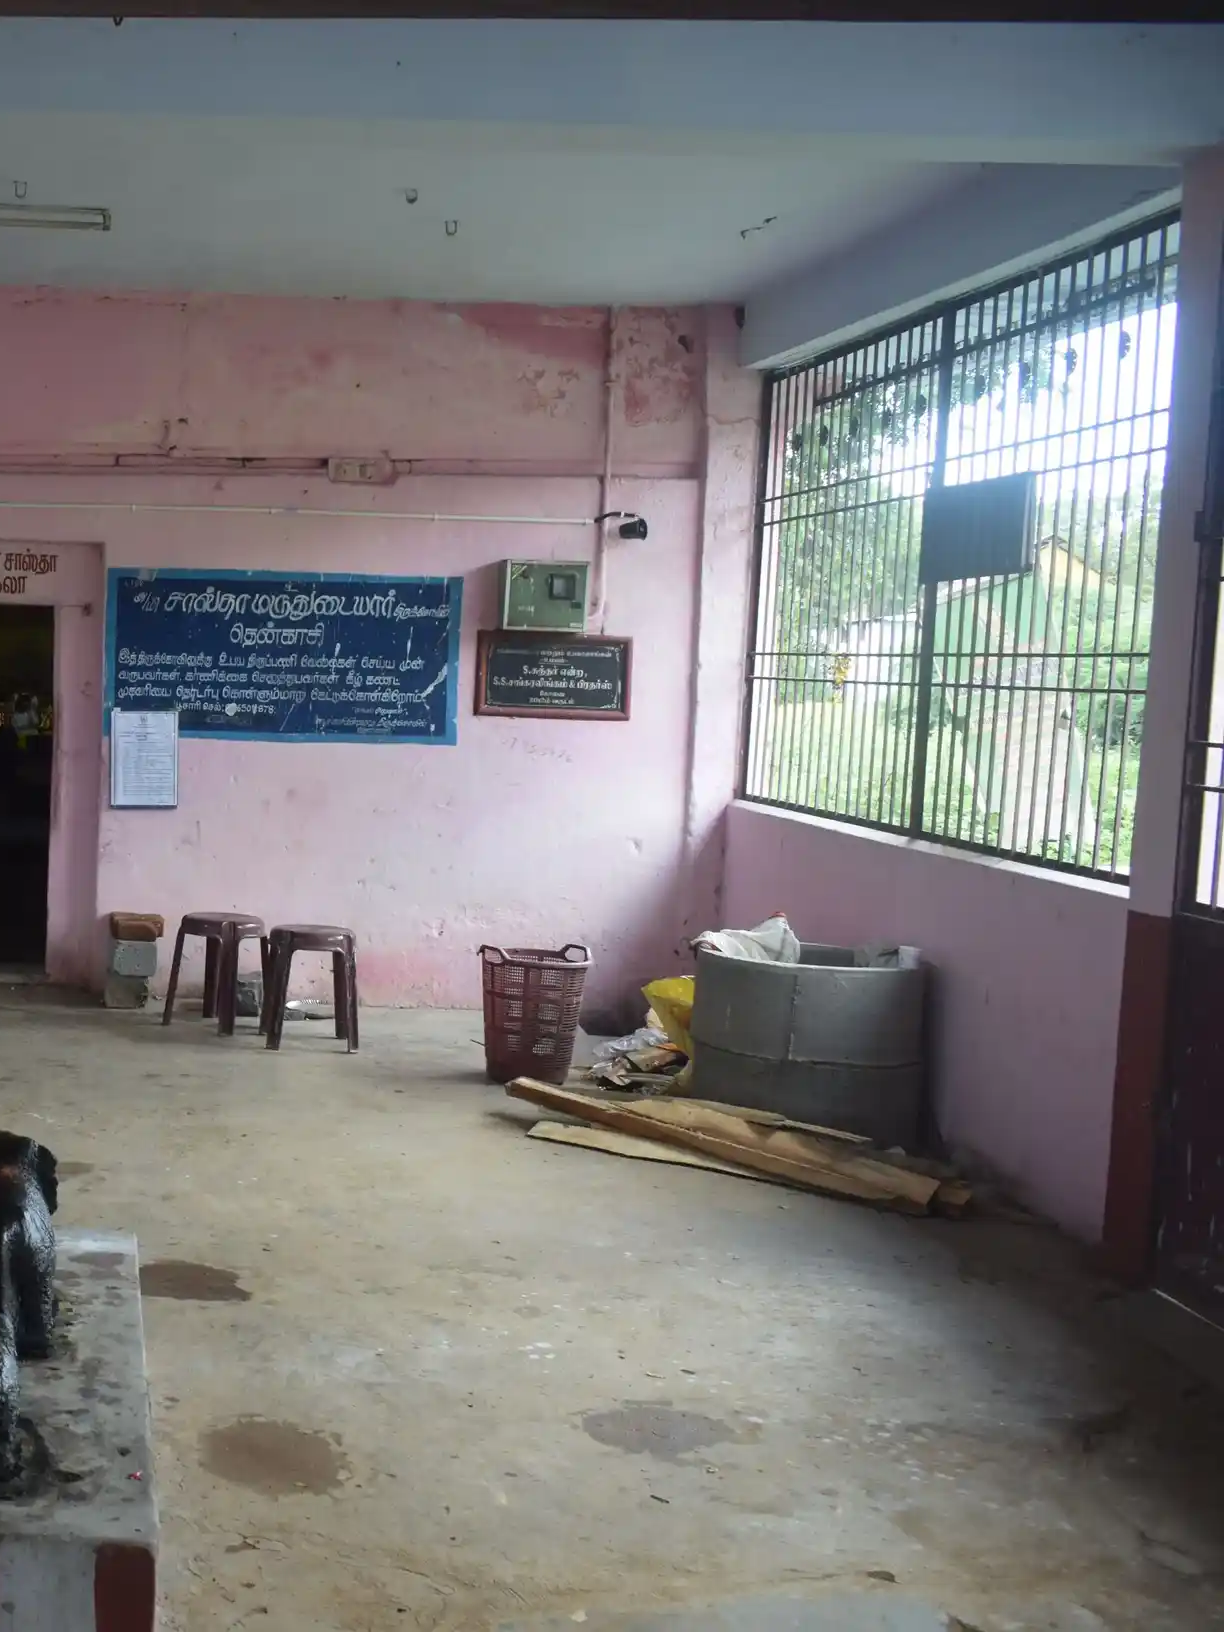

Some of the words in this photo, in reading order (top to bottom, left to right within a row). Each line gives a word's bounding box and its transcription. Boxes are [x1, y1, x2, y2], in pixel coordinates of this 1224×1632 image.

[4, 548, 59, 574] சாஸ்தா
[164, 585, 251, 620] சாஸ்தா
[252, 588, 396, 621] மருதுடையார்
[230, 621, 325, 648] தென்காசி
